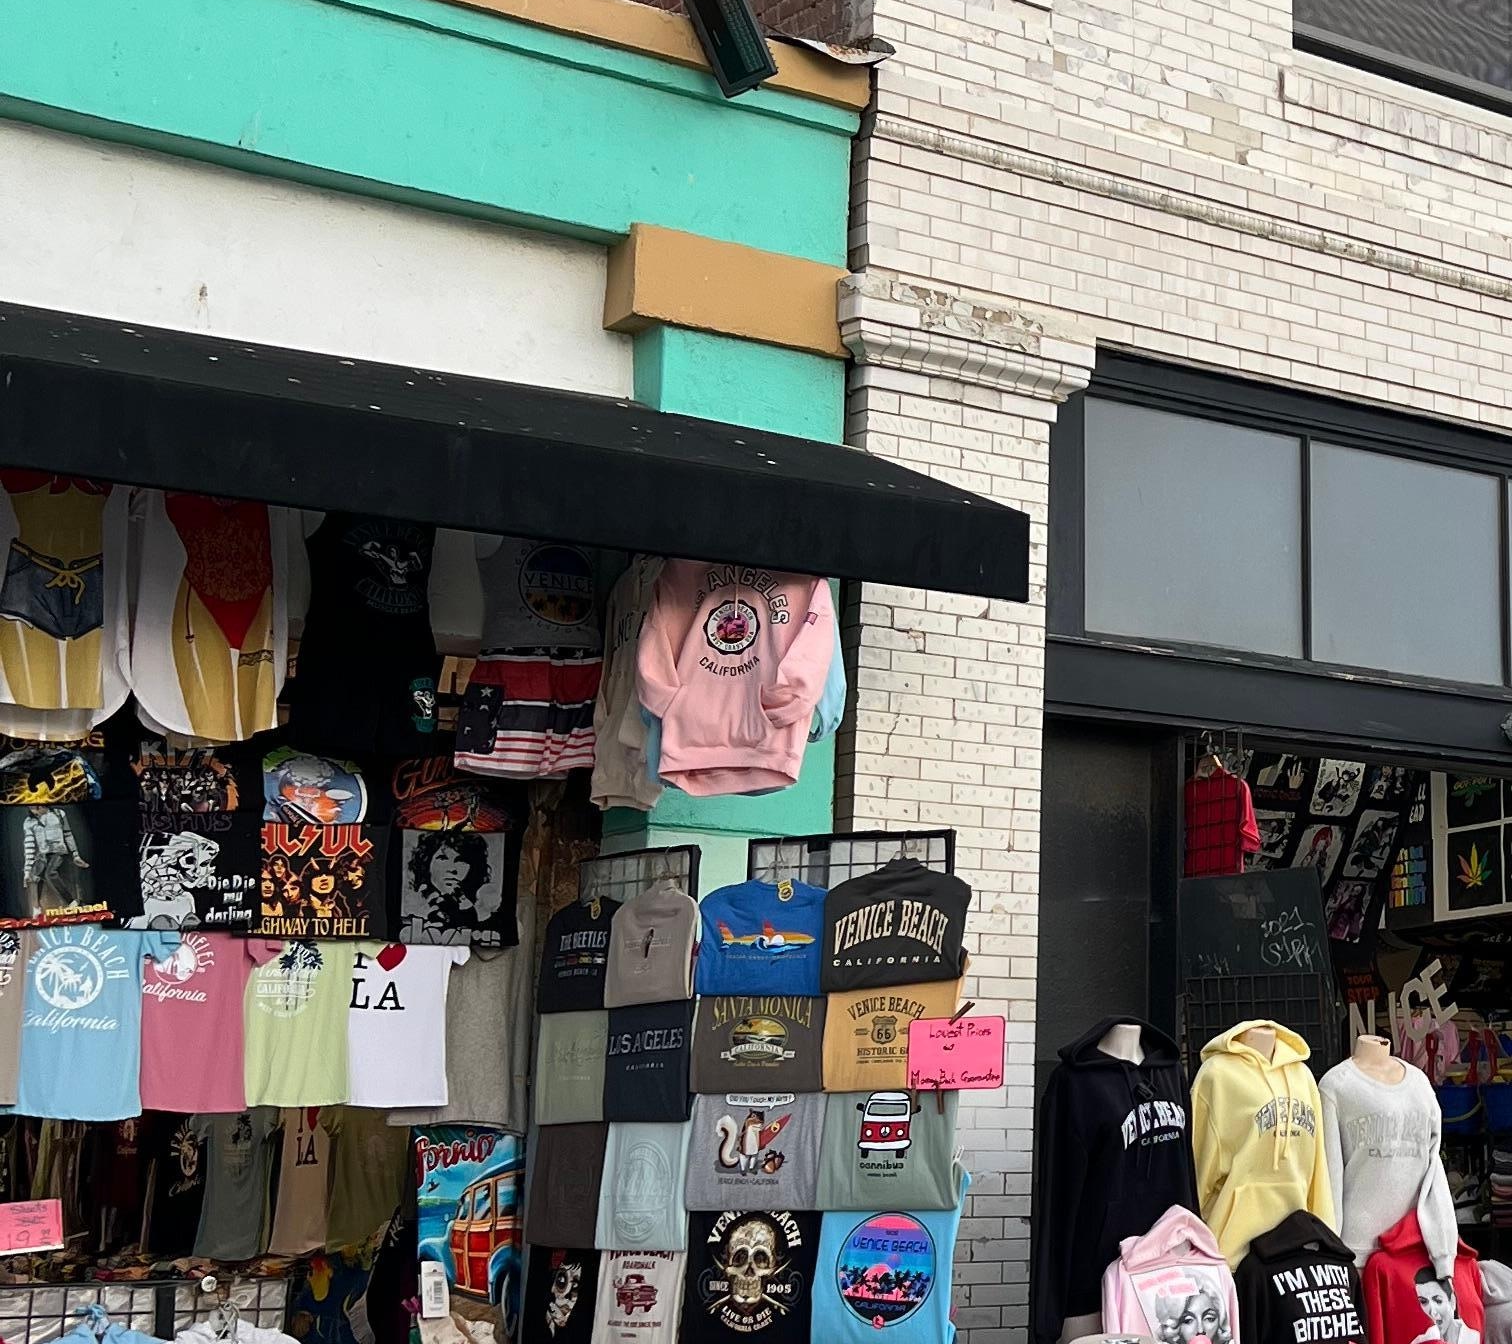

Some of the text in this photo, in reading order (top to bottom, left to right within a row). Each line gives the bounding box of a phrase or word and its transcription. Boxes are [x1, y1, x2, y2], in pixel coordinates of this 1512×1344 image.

[46, 902, 108, 917] michael
[205, 907, 252, 926] darling
[312, 918, 330, 936] TO
[333, 918, 369, 936] HELL
[833, 899, 949, 956] VENICE BEACH
[80, 926, 130, 979] BEACH
[833, 956, 941, 967] CALIFORNIA
[349, 978, 405, 1011] LA
[711, 996, 813, 1031] SANTA MONICA
[847, 996, 926, 1021] VENICE BEACH
[877, 1028, 891, 1040] 66
[857, 1046, 897, 1057] HISTORIC
[770, 1211, 802, 1248] EACH
[853, 1237, 928, 1253] VENICE BEACH
[766, 1283, 792, 1295] 1905
[1273, 1264, 1349, 1296] I'M WITH
[1296, 1289, 1354, 1314] THESE
[721, 1304, 739, 1324] LIVE
[757, 1307, 772, 1323] DIE
